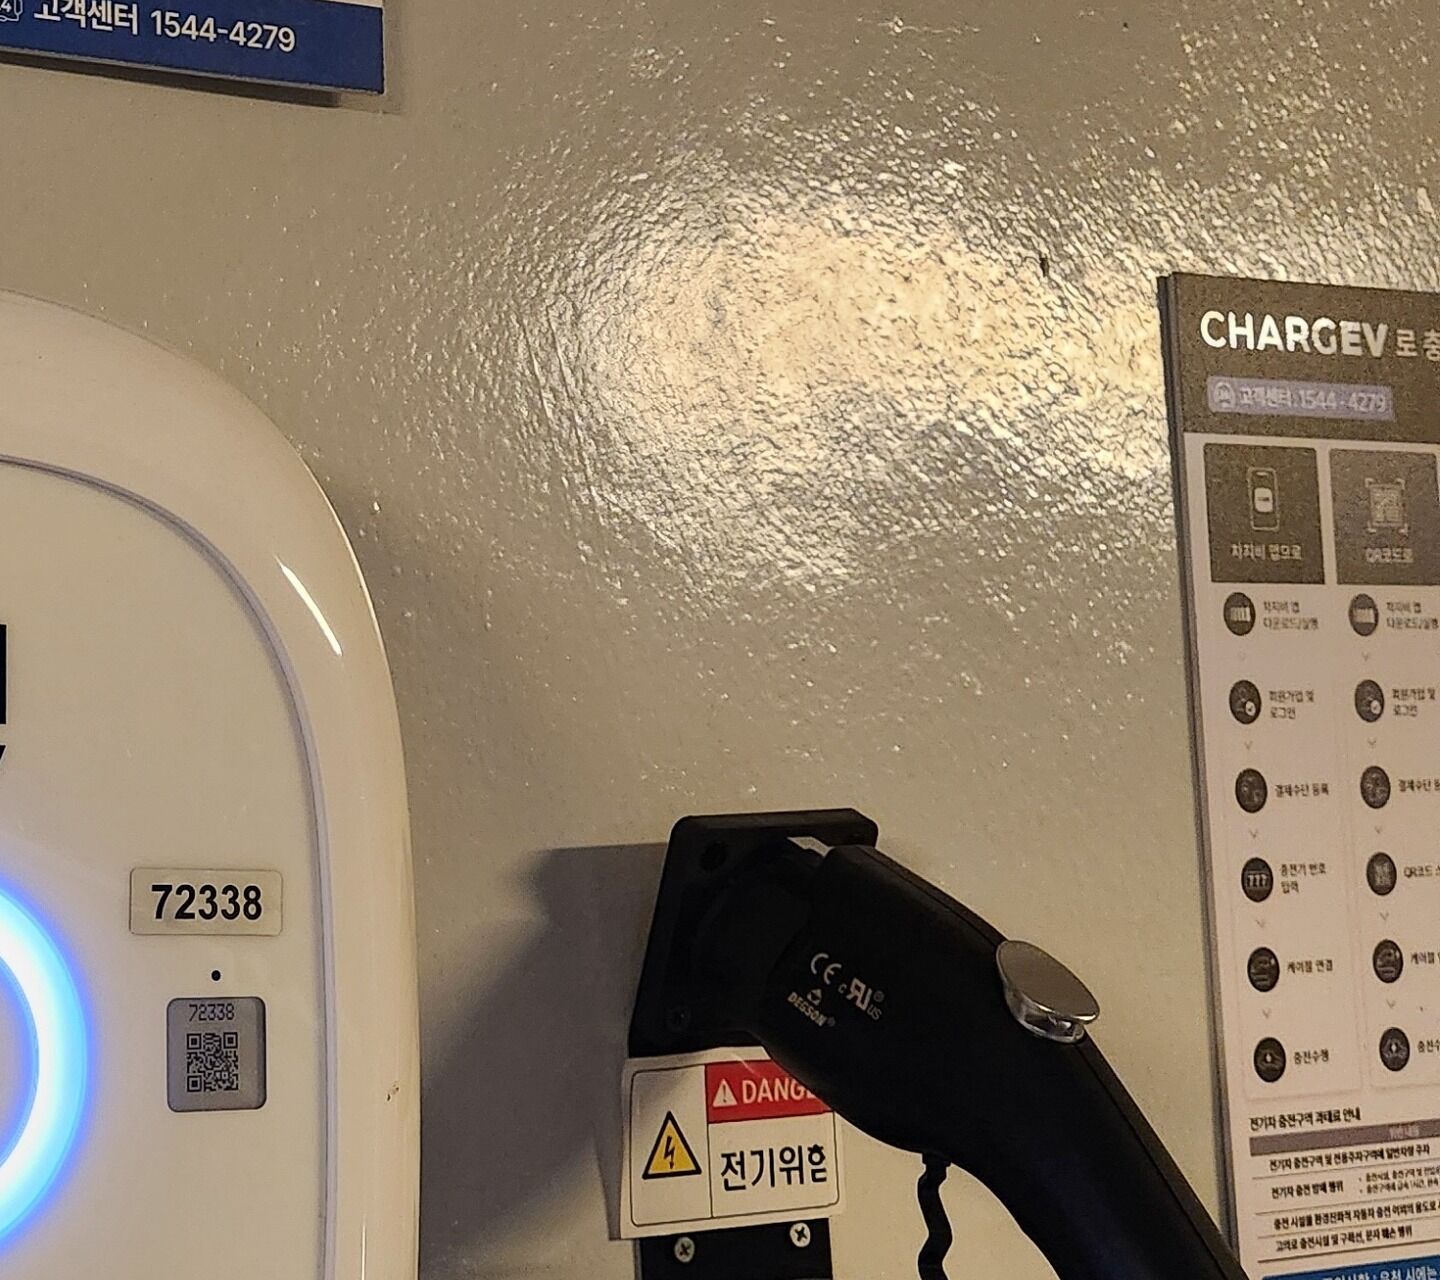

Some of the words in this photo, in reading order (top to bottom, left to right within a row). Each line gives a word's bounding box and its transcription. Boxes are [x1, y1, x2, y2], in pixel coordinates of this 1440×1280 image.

[150, 8, 297, 54] 1544-4279
[1200, 310, 1388, 358] CHARGEV
[151, 884, 263, 921] 72338
[189, 1004, 235, 1022] 72338
[741, 1078, 816, 1104] DANG
